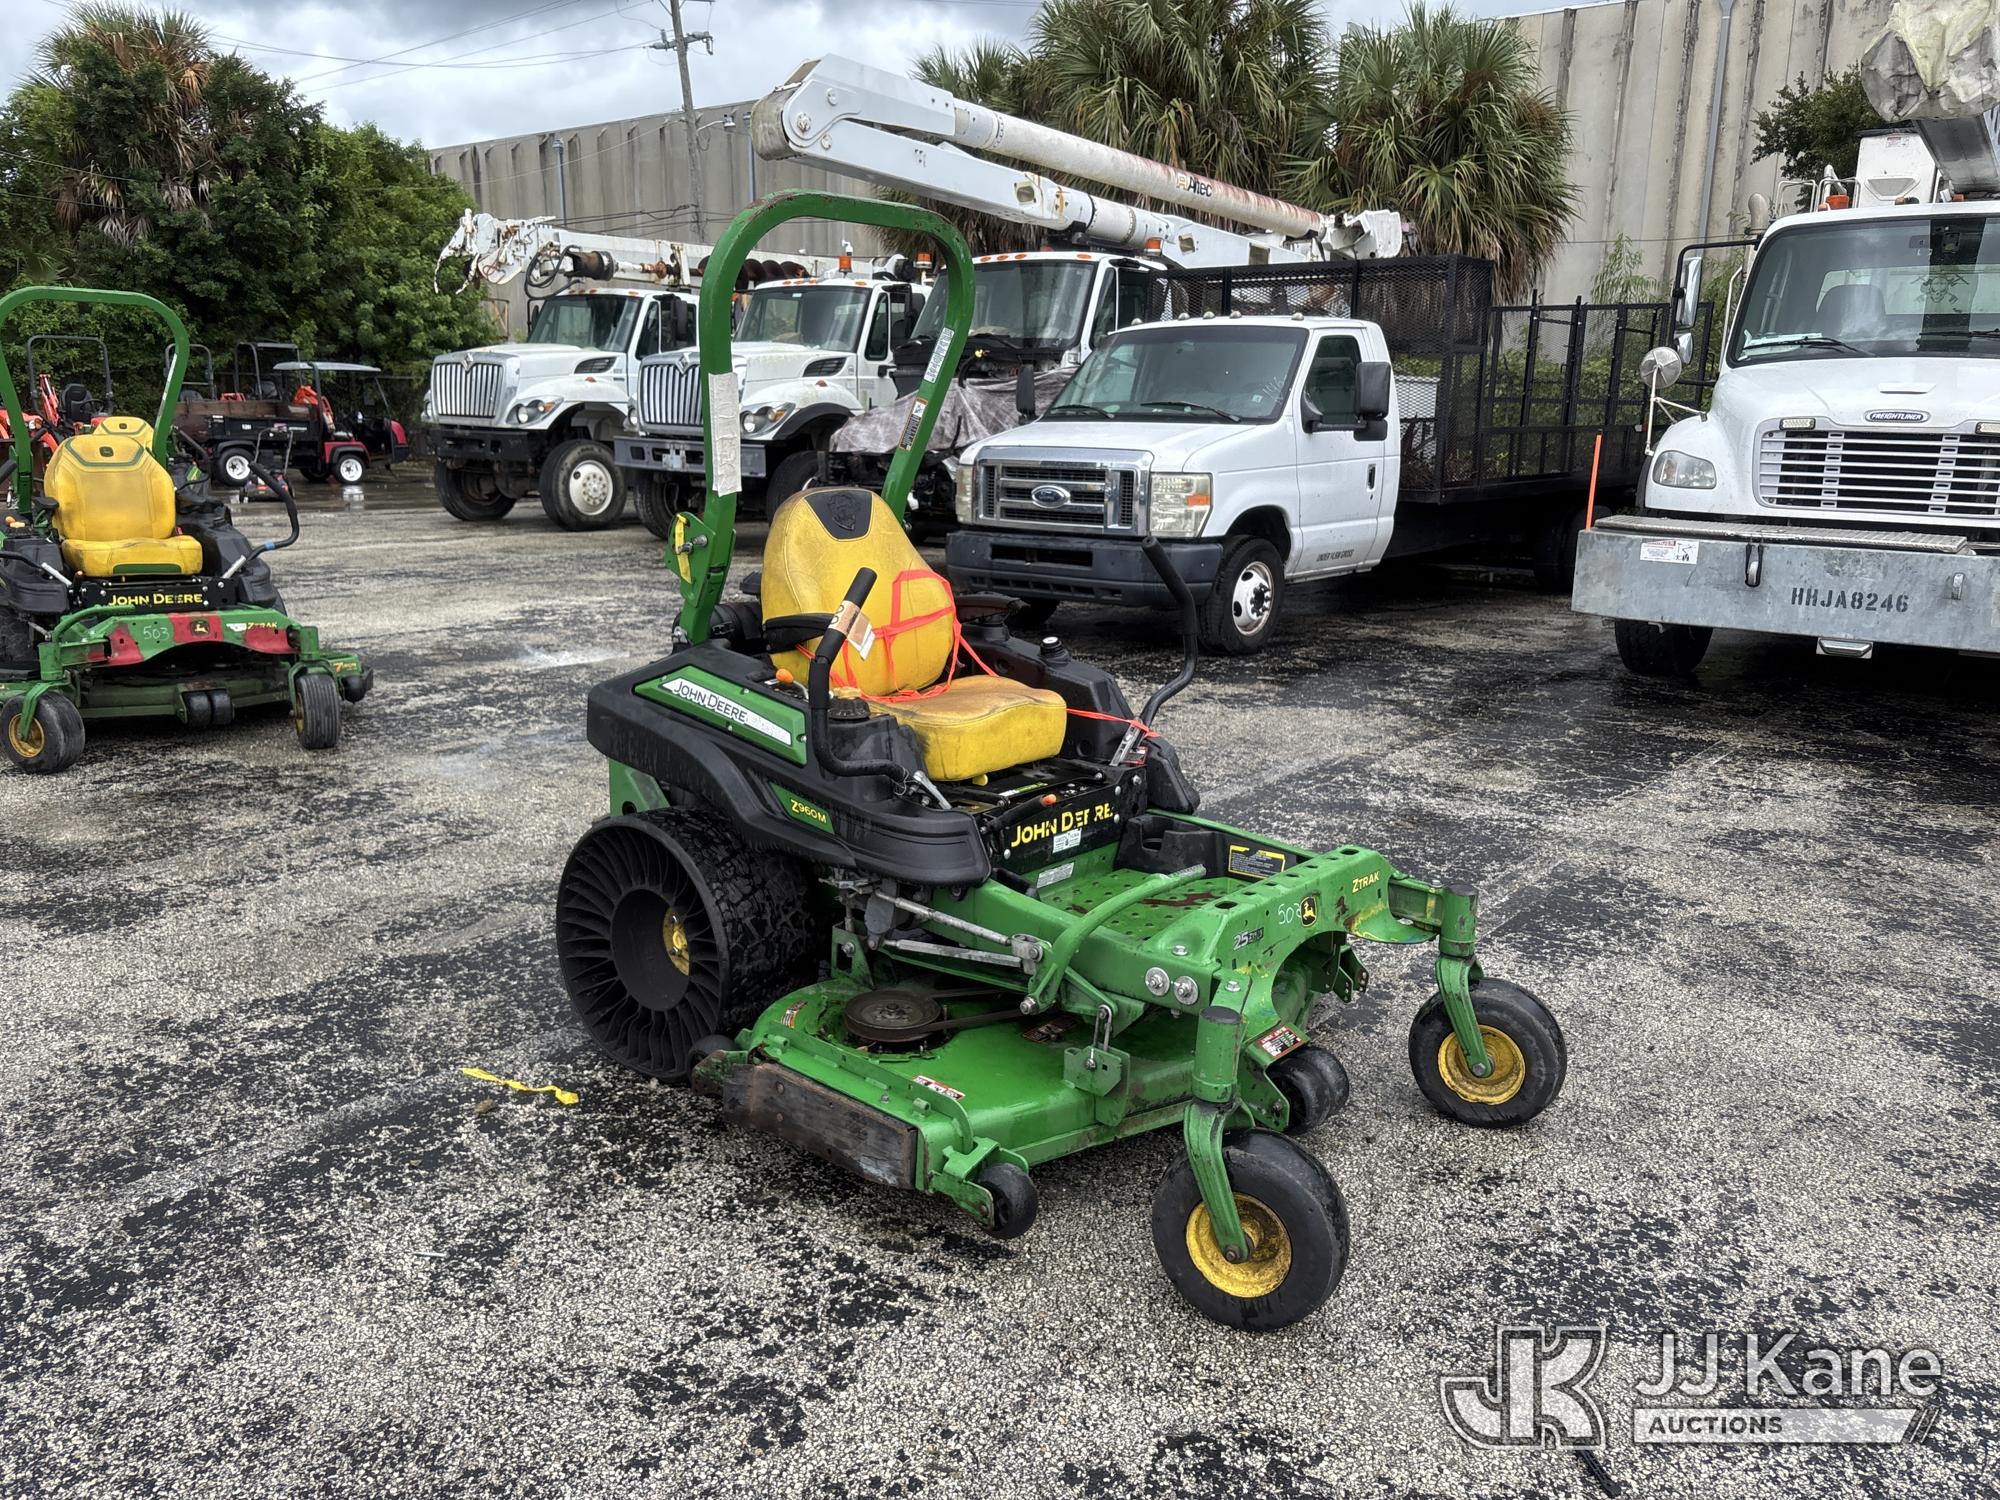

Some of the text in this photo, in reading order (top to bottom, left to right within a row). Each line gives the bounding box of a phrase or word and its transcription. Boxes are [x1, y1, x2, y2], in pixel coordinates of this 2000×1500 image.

[1871, 412, 1922, 420] FREIGHTLINER
[108, 593, 203, 606] JOHN DEERE
[1791, 587, 1909, 612] HHJA8246
[143, 626, 170, 641] 503
[674, 681, 748, 722] JOHN DEERE
[790, 799, 826, 823] Z960M
[1011, 818, 1057, 848] JOHN
[1352, 871, 1380, 893] ZTRAK
